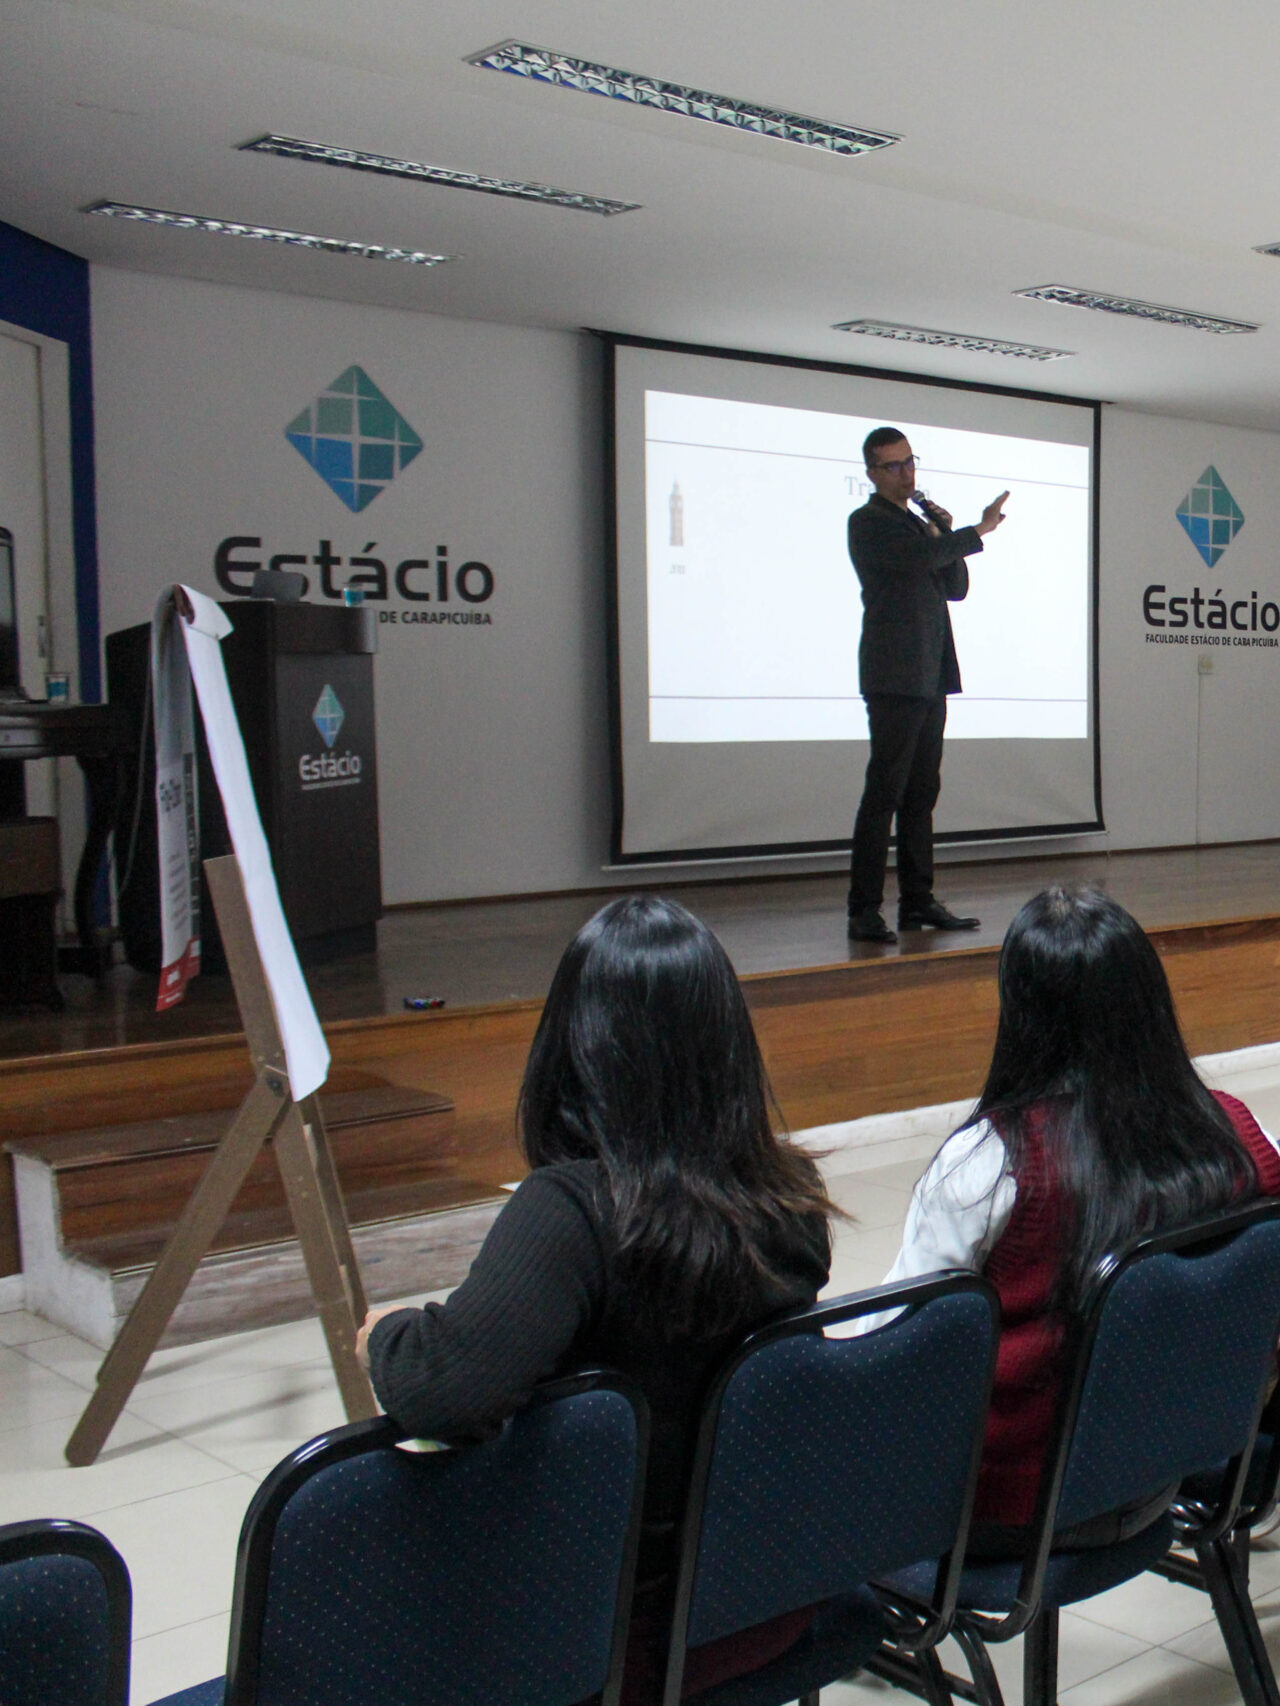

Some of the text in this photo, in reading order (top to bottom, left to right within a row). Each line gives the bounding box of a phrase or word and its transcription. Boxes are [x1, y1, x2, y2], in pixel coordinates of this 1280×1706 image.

[379, 611, 492, 625] DE CARAPICUÍBA
[1143, 585, 1280, 633] Estácio
[1145, 634, 1279, 648] FACULDADE ESTÁCIO DE CARAPICUÍBA
[299, 750, 361, 779] Estácio
